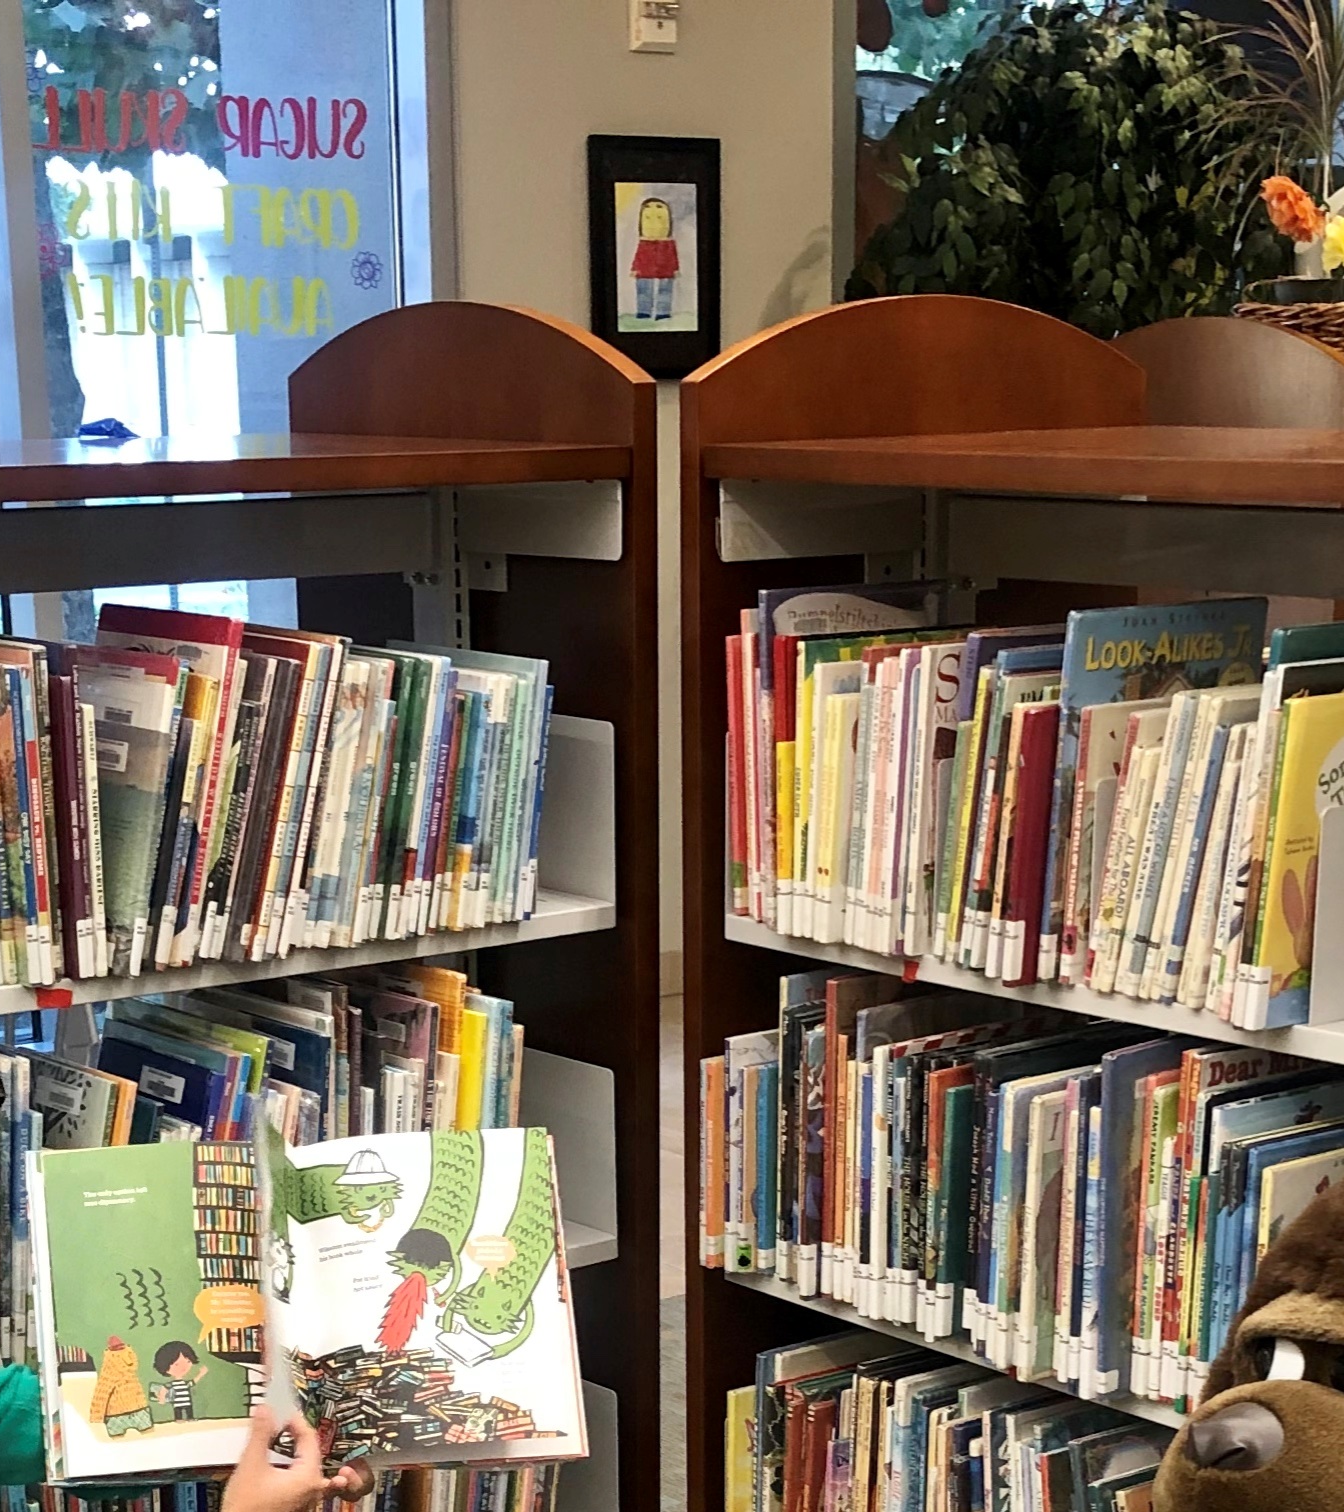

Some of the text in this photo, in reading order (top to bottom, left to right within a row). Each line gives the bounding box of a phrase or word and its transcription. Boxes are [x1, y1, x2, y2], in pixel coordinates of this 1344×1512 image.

[388, 762, 401, 796] green
[406, 761, 418, 795] green
[30, 778, 41, 822] DINOSAUR
[34, 838, 44, 876] BEDTIME
[1113, 835, 1135, 918] ALL ABOARD!
[1208, 1053, 1263, 1087] Dear
